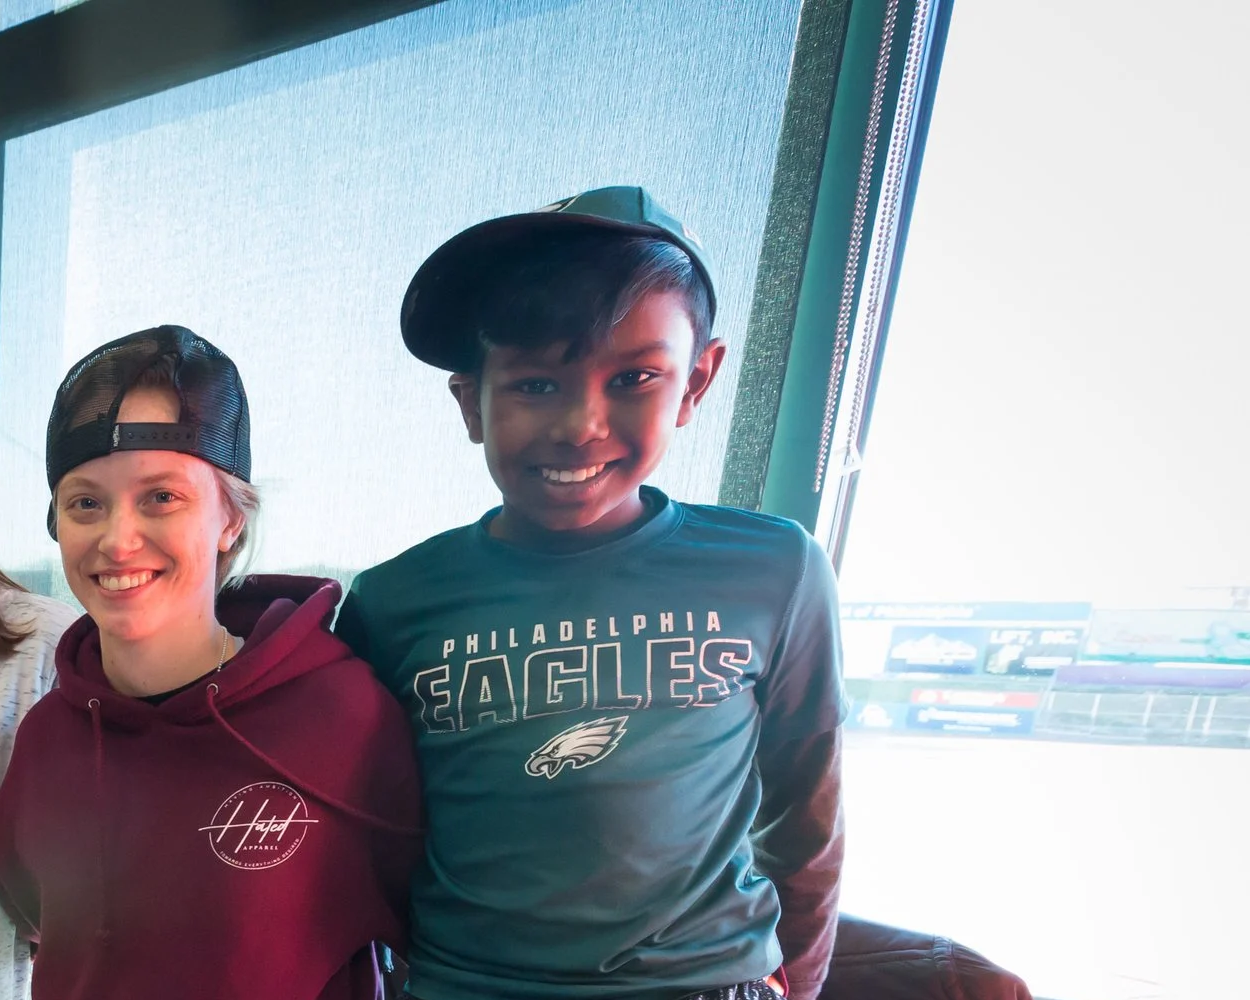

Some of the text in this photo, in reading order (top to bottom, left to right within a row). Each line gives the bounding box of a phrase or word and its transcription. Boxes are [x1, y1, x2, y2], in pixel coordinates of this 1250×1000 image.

[442, 610, 723, 661] PHILADELPHIA
[414, 637, 754, 736] EAGLES
[243, 857, 280, 867] EVERYTHING
[281, 837, 300, 858] DESIRED
